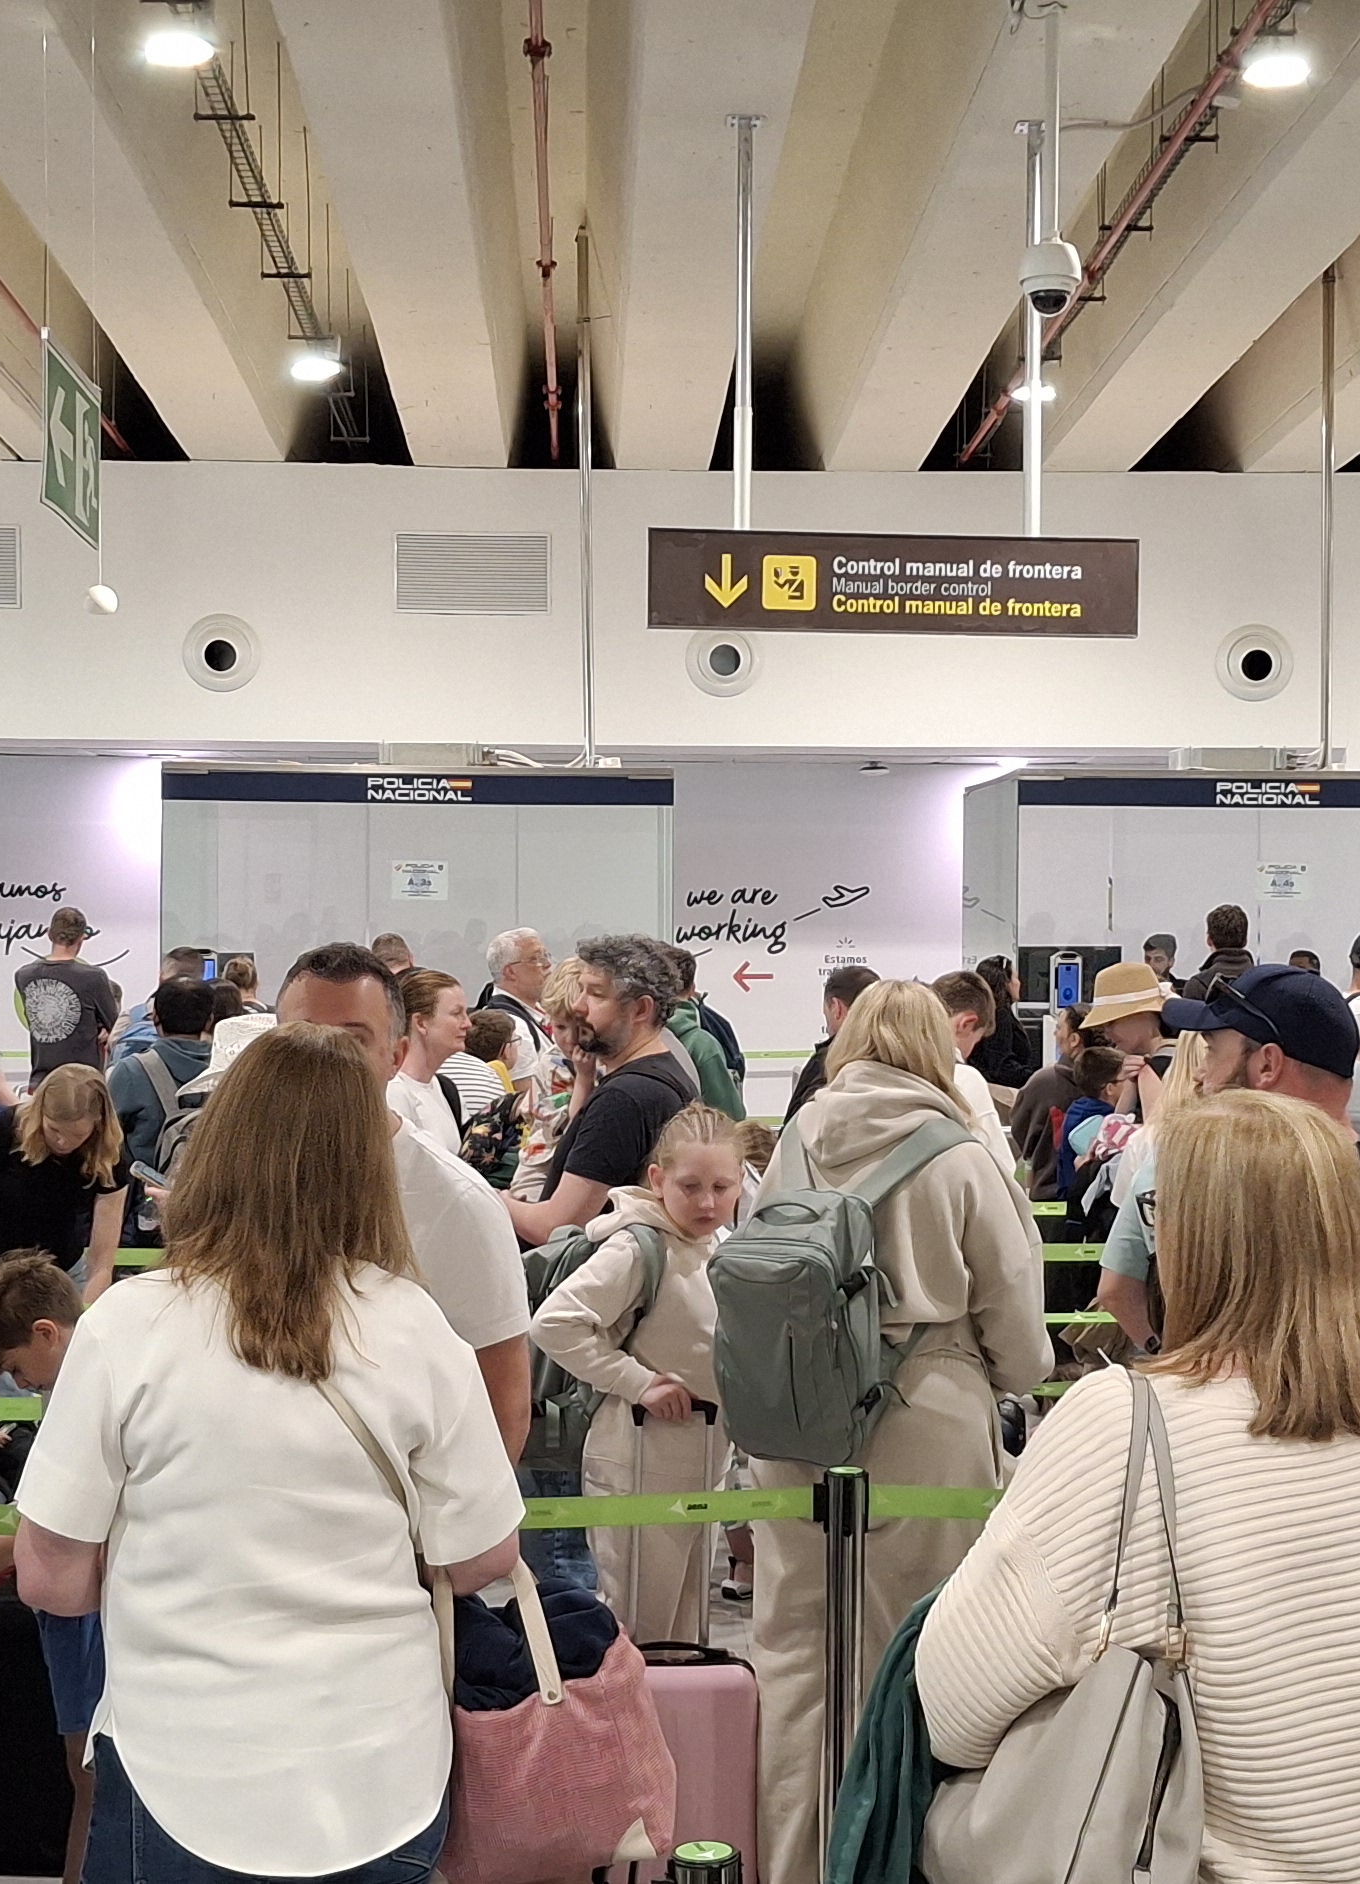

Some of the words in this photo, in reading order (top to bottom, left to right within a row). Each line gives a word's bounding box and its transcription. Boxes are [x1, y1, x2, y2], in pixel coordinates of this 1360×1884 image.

[832, 556, 900, 576] Control
[905, 559, 974, 578] manual
[979, 559, 1003, 578] de
[1008, 560, 1083, 580] frontera
[832, 576, 884, 595] Manual
[887, 578, 937, 596] border
[940, 580, 992, 597] control
[832, 594, 900, 614] Control
[904, 596, 973, 615] manual
[978, 597, 1002, 616] de
[1006, 598, 1082, 618] frontera
[367, 777, 451, 790] POLICIA
[1215, 782, 1300, 794] POLICIA
[367, 789, 473, 802] NACIONAL
[1215, 793, 1321, 805] NACIONAL
[686, 887, 724, 907] we
[730, 886, 778, 906] are
[675, 909, 788, 955] working
[824, 954, 868, 964] Estamos
